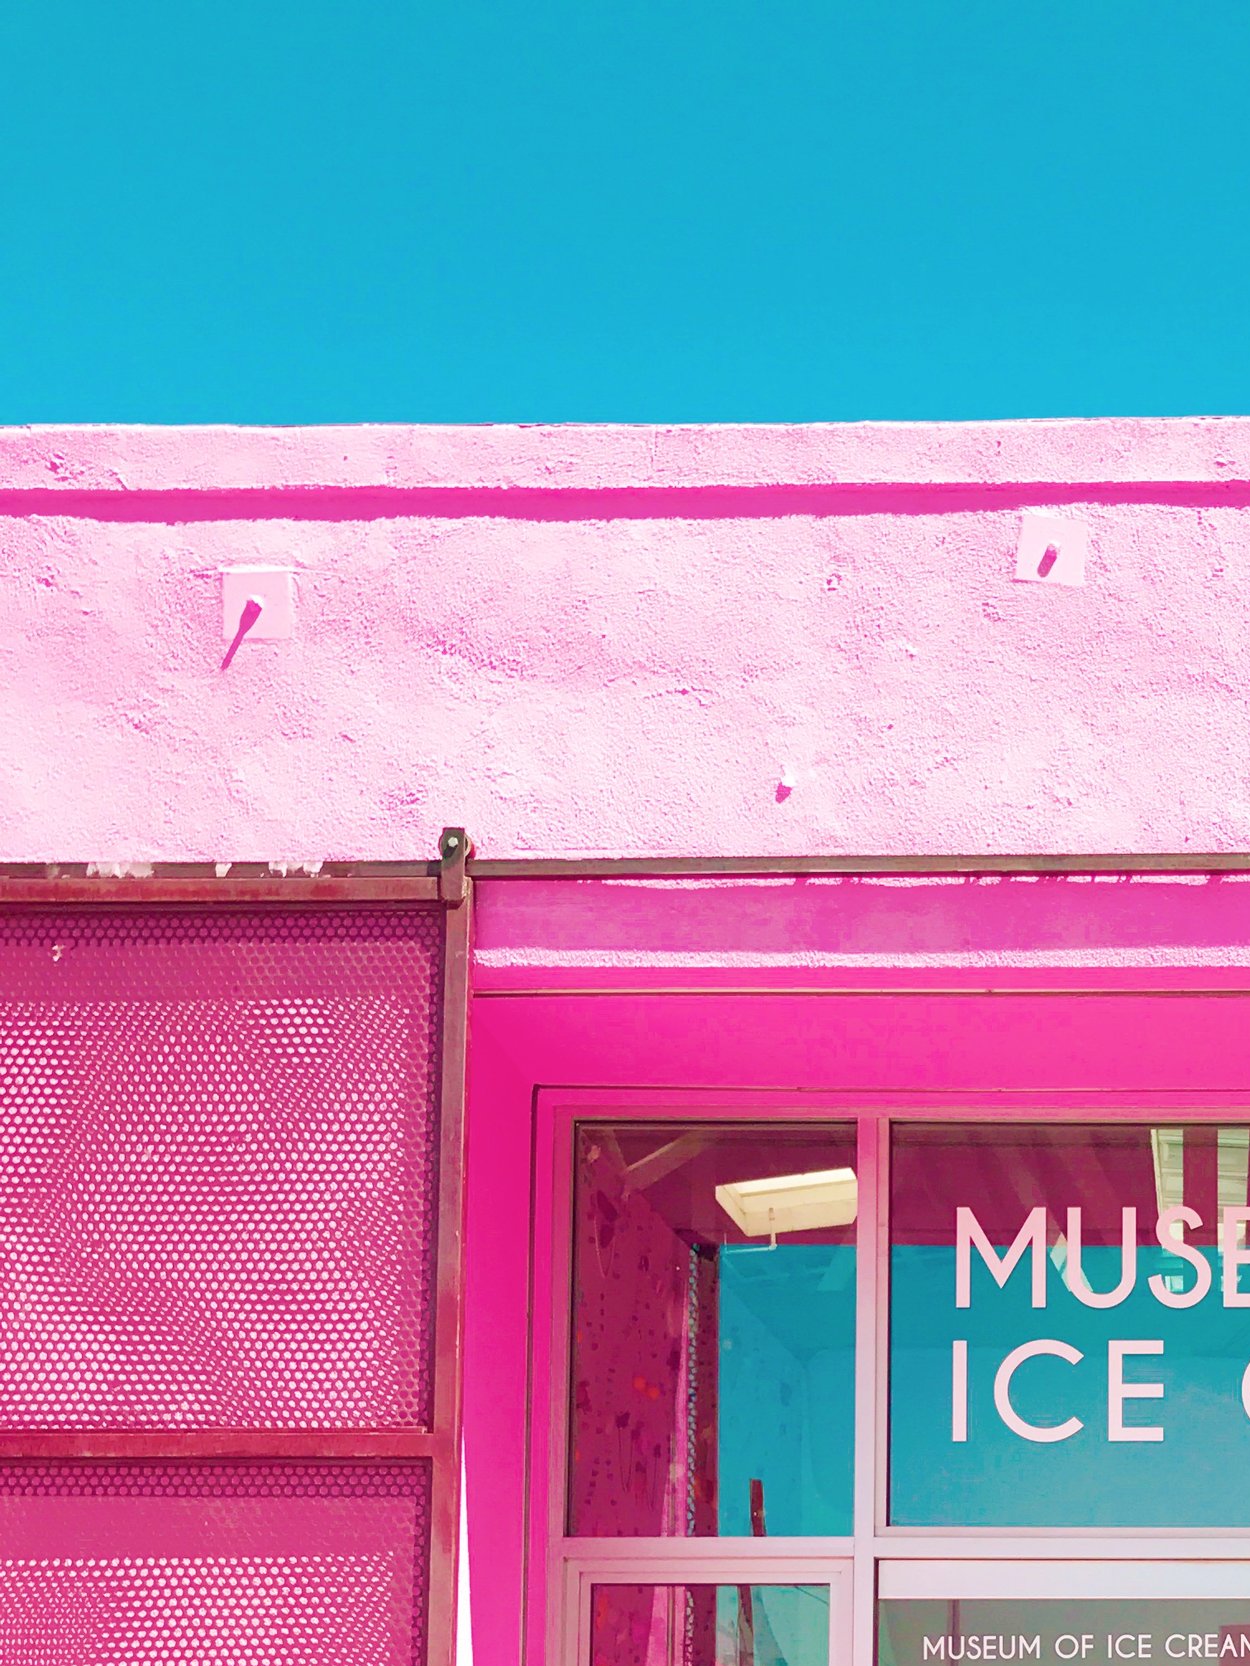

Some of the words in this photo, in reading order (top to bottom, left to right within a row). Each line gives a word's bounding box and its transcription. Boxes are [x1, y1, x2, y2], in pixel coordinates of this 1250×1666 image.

[952, 1339, 1164, 1442] ICE
[923, 1634, 1041, 1661] MUSEUM
[1054, 1634, 1094, 1659] OF
[1107, 1633, 1152, 1659] ICE
